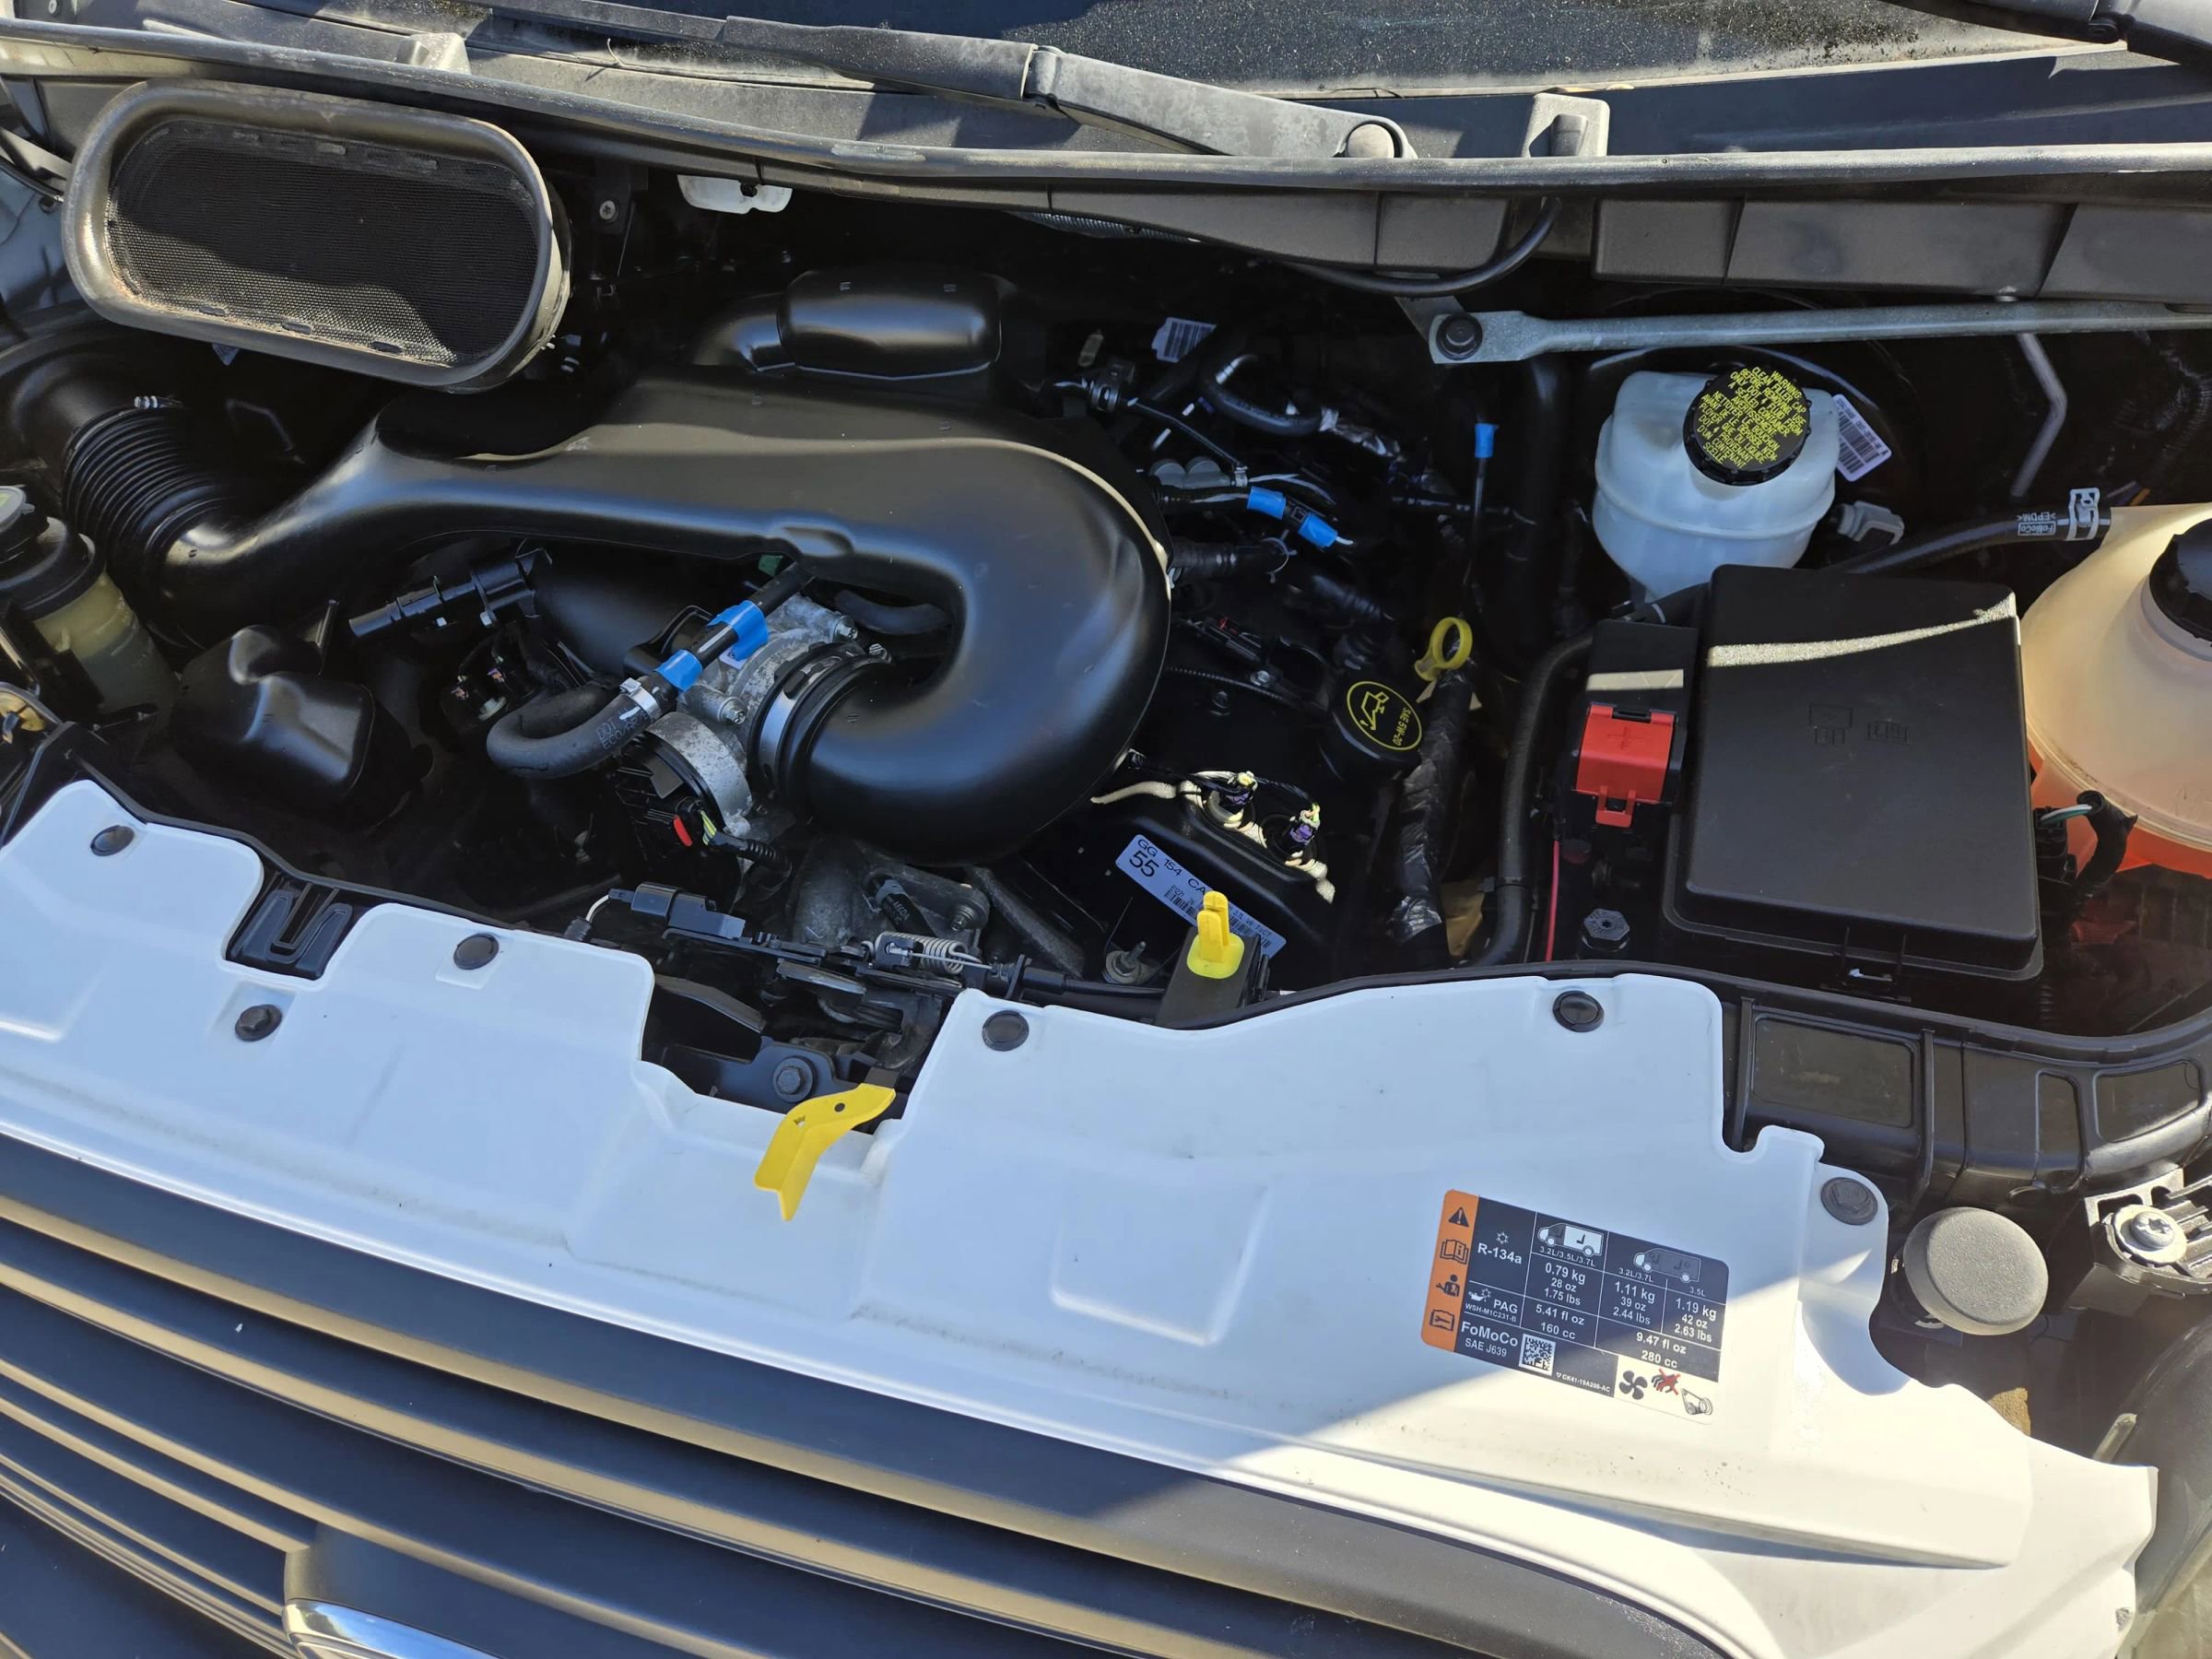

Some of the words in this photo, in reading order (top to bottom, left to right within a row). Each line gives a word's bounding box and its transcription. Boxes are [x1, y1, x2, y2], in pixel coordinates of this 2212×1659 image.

[1735, 386, 1759, 408] SEALED
[1751, 366, 1772, 385] CLEAN
[1771, 383, 1793, 403] FILLER
[1791, 402, 1806, 415] CAP
[1771, 371, 1804, 401] WARNING:
[1730, 371, 1749, 388] ONLY
[1746, 385, 1761, 398] DOT
[1766, 403, 1785, 420] FLUID
[1783, 418, 1803, 436] FROM
[1739, 368, 1764, 389] BEFORE
[1791, 414, 1806, 427] USE
[1701, 393, 1722, 411] AVANT
[1719, 408, 1730, 418] DE
[1728, 417, 1739, 426] LE
[1712, 391, 1744, 418] NETTOYER
[1741, 417, 1753, 427] LE
[1698, 415, 1714, 429] DOT
[1718, 431, 1753, 464] PROVENANT
[1699, 403, 1723, 424] PLOYER
[1721, 422, 1736, 436] QUE
[1734, 434, 1746, 444] DU
[1744, 442, 1767, 464] LIQUIDE
[1711, 437, 1747, 469] CONTENANT
[2020, 524, 2053, 534] FoMoCo
[1399, 707, 1411, 724] SAE
[1393, 721, 1407, 746] 5W-20
[1129, 851, 1159, 877] 55
[1137, 840, 1158, 855] GG
[1163, 860, 1182, 875] 154
[1477, 1242, 1523, 1264] R-134a
[1540, 1246, 1596, 1267] 3.2L/3.5L/3.7L
[1546, 1262, 1569, 1278] 0.79
[1571, 1269, 1586, 1286] kg
[1551, 1277, 1562, 1288] 28
[1565, 1283, 1577, 1292] oz
[1618, 1267, 1654, 1283] 3.2L/3.7L
[1544, 1288, 1564, 1301] 1.75
[1566, 1293, 1581, 1306] lbs
[1615, 1281, 1638, 1297] 1.11
[1641, 1288, 1655, 1304] kg
[1689, 1287, 1706, 1297] 3.5L
[1493, 1299, 1518, 1314] PAG
[1535, 1303, 1558, 1318] 5.41
[1561, 1311, 1569, 1321] fl
[1571, 1315, 1584, 1325] oz
[1621, 1296, 1632, 1308] 39
[1635, 1301, 1646, 1312] oz
[1676, 1298, 1699, 1313] 1.19
[1701, 1304, 1717, 1322] kg
[1613, 1306, 1633, 1320] 2.44
[1636, 1312, 1651, 1325] lbs
[1682, 1312, 1694, 1325] 42
[1696, 1318, 1708, 1329] oz
[1462, 1321, 1519, 1347] FoMoCo
[1540, 1322, 1559, 1335] 160
[1562, 1329, 1576, 1339] cc
[1675, 1324, 1695, 1337] 2.63
[1697, 1329, 1712, 1343] lbs
[1465, 1337, 1485, 1351] SAE
[1487, 1344, 1507, 1358] J639
[1636, 1331, 1659, 1347] 9.47
[1662, 1338, 1670, 1350] fl
[1673, 1344, 1687, 1354] oz
[1641, 1349, 1662, 1364] 280
[1664, 1359, 1677, 1369] cc
